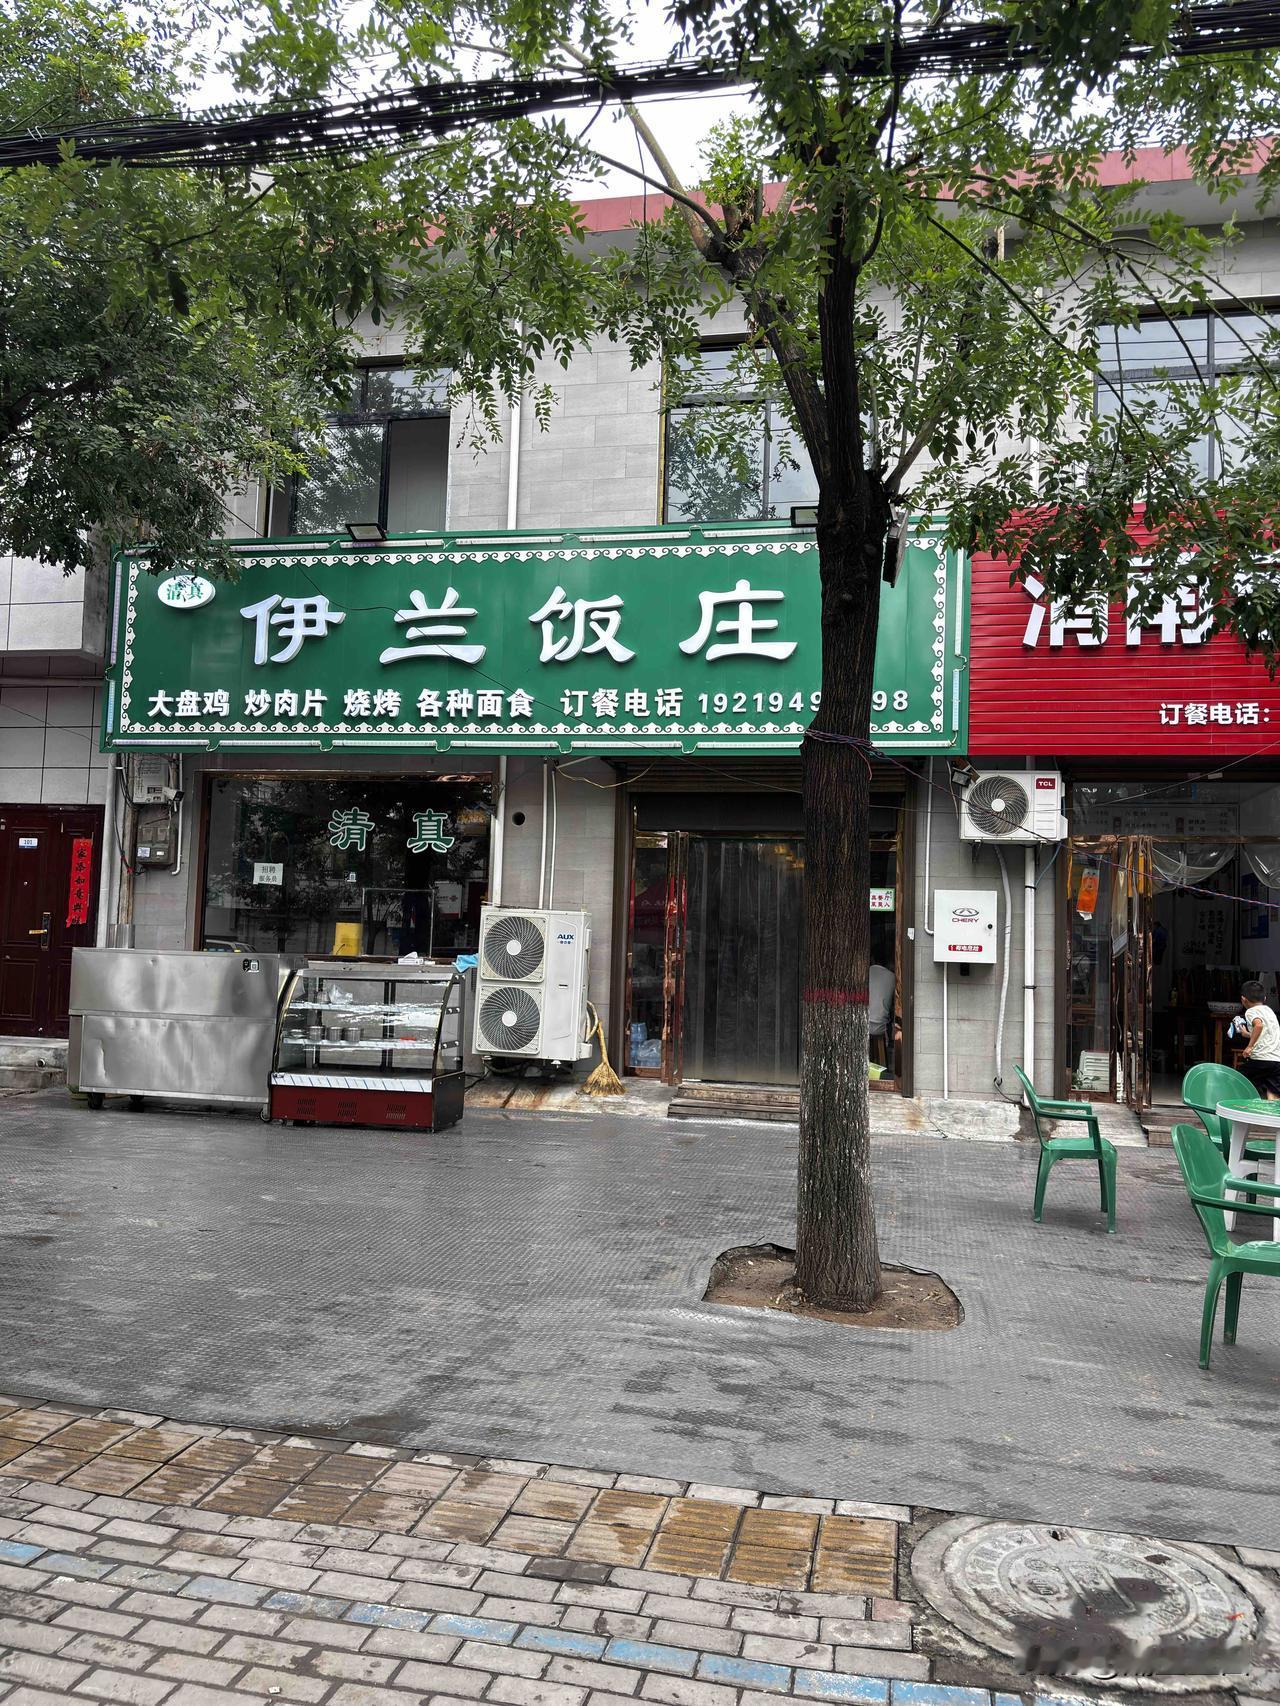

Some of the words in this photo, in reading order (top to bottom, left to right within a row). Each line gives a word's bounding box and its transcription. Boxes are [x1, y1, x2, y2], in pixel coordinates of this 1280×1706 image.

[240, 579, 797, 664] 伊兰饭庄
[148, 689, 229, 716] 大盘鸡
[244, 689, 327, 716] 炒肉片
[344, 689, 401, 716] 烧烤
[417, 689, 534, 717] 各种面食
[560, 688, 683, 717] 订餐电话
[699, 691, 907, 713] 192194998
[328, 806, 454, 853] 清真
